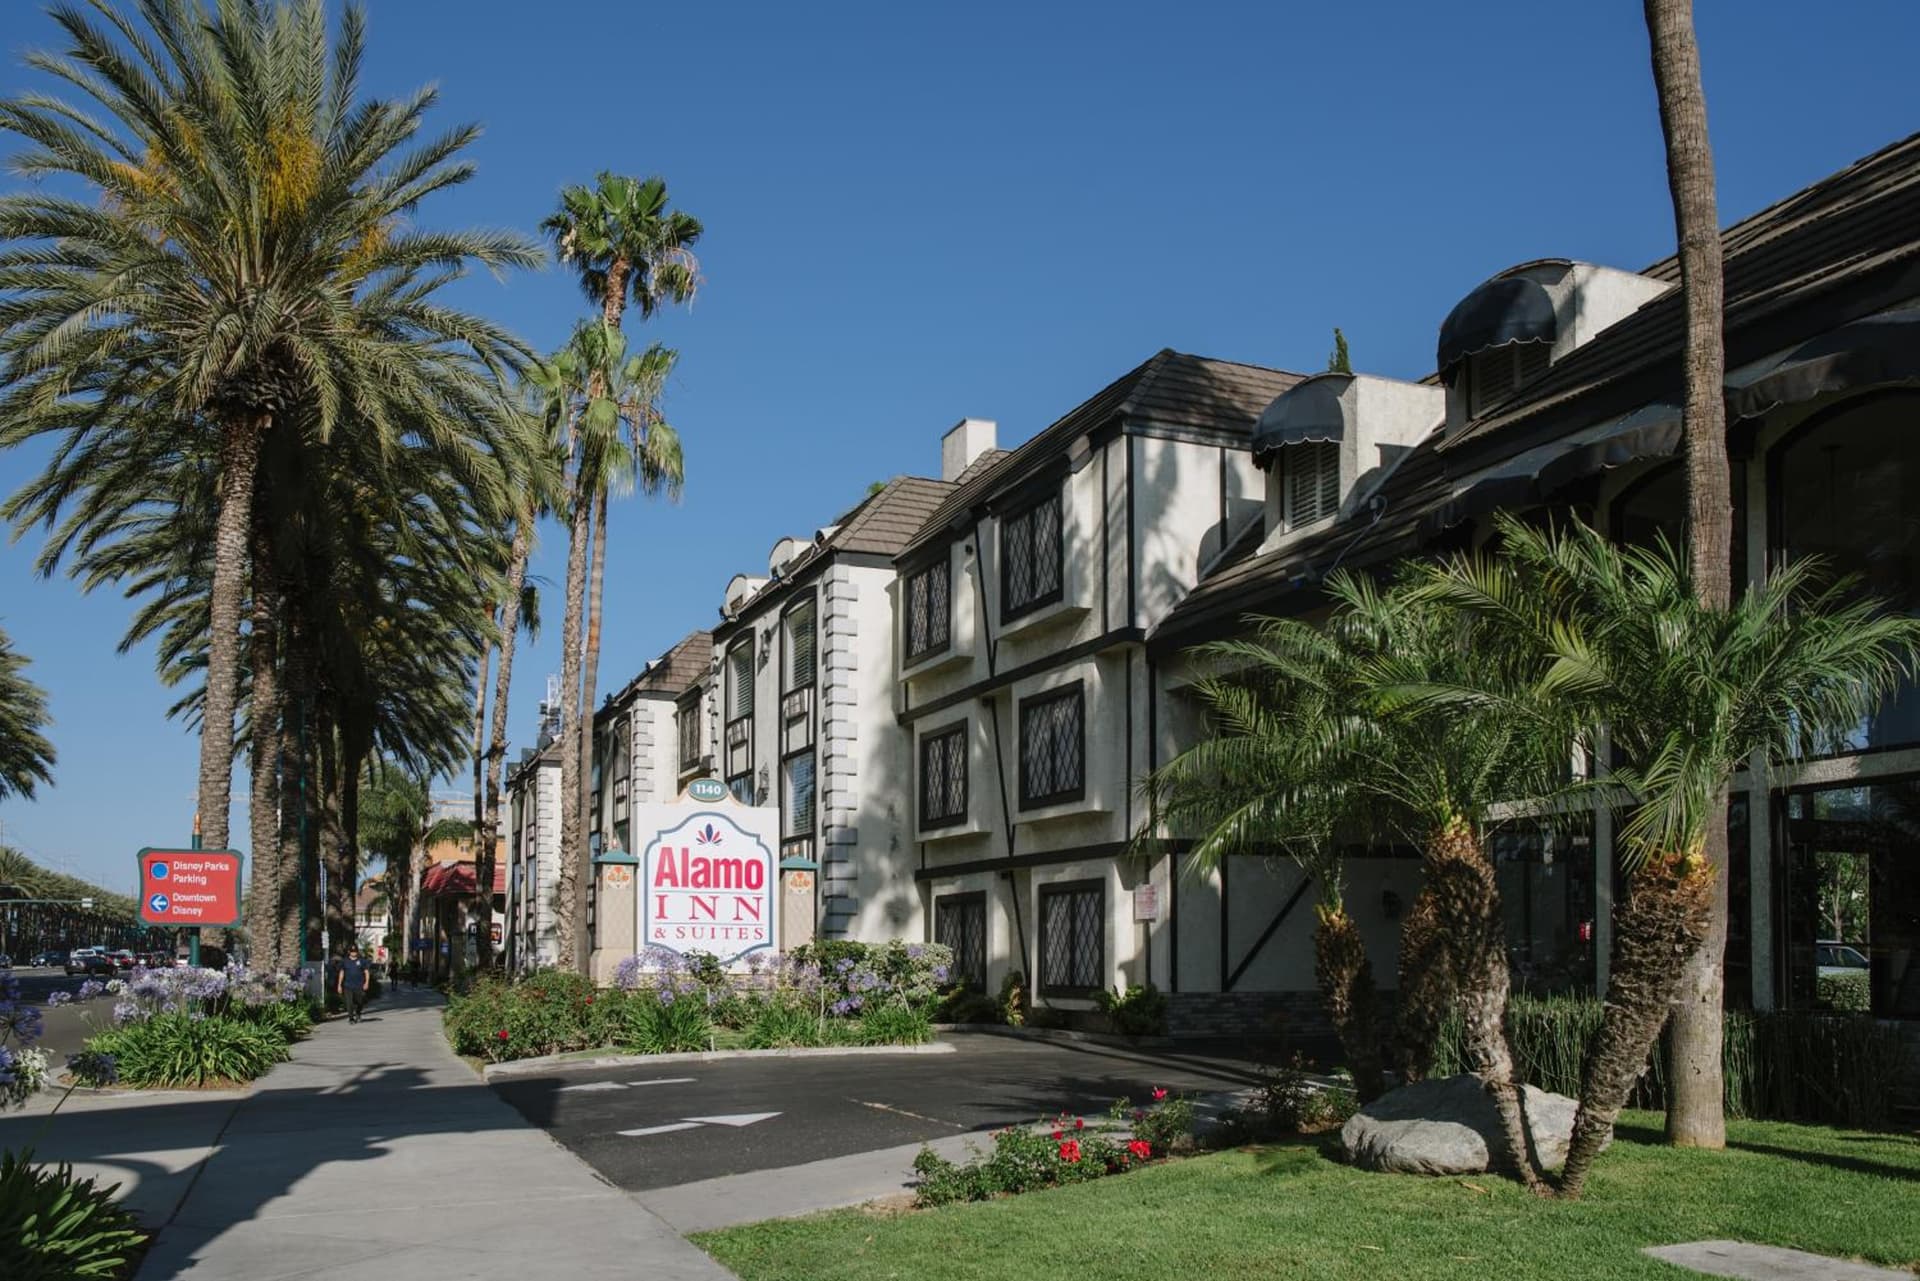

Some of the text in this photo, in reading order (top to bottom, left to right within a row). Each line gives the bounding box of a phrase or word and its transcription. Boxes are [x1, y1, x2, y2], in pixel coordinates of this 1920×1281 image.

[695, 784, 722, 796] 1140
[173, 861, 229, 872] Disney Parks
[654, 846, 763, 890] Alamo
[173, 874, 207, 885] Parking
[172, 893, 216, 903] Downtown
[172, 906, 203, 917] Disney
[655, 895, 763, 921] INN
[654, 927, 764, 940] & SUITES
